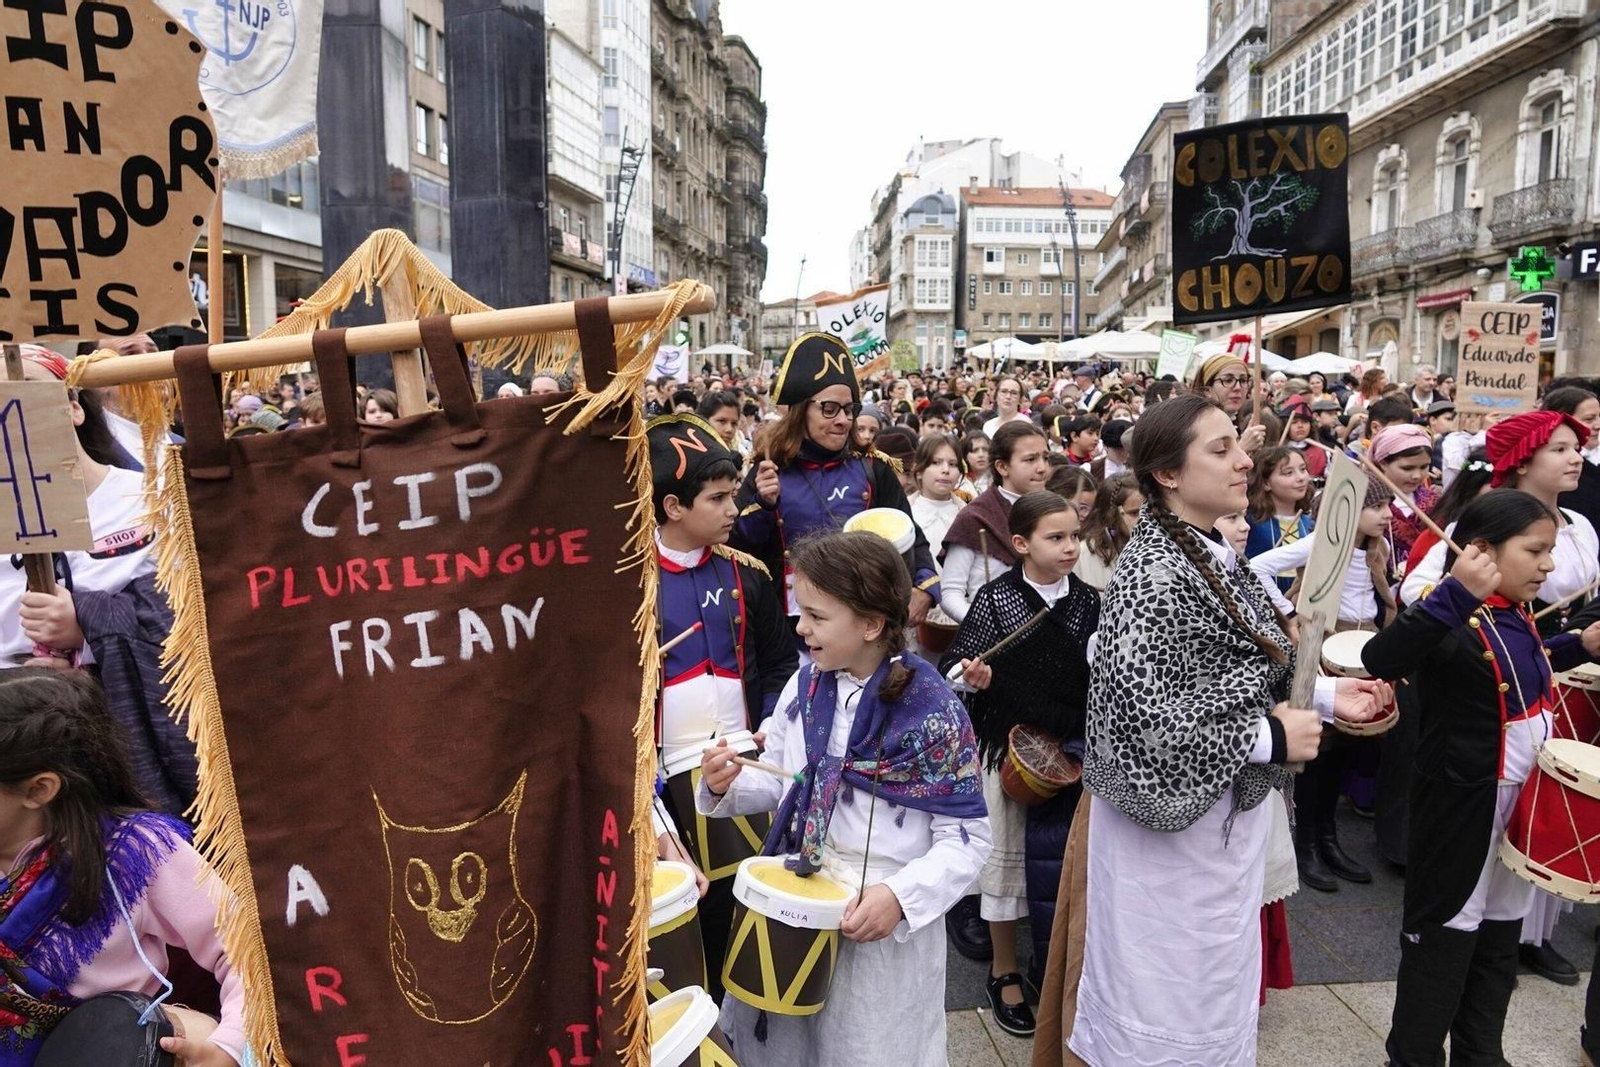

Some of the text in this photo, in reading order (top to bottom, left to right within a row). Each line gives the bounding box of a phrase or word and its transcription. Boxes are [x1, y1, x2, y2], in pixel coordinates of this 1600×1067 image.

[4, 96, 101, 155] AN
[1175, 125, 1347, 187] COLEXIO
[1177, 254, 1344, 312] CHOUZO
[0, 283, 140, 343] IS
[825, 300, 885, 334] OLEXIO
[1481, 311, 1531, 335] CEIP
[814, 351, 847, 380] N
[1462, 344, 1537, 364] Eduardo
[1465, 370, 1528, 390] Pondal
[669, 428, 708, 479] N
[301, 462, 503, 538] CEIP
[104, 529, 137, 546] SHOP
[246, 527, 592, 609] PLURILINGÜE
[329, 597, 545, 679] FRIAN
[779, 909, 808, 922] XULIA
